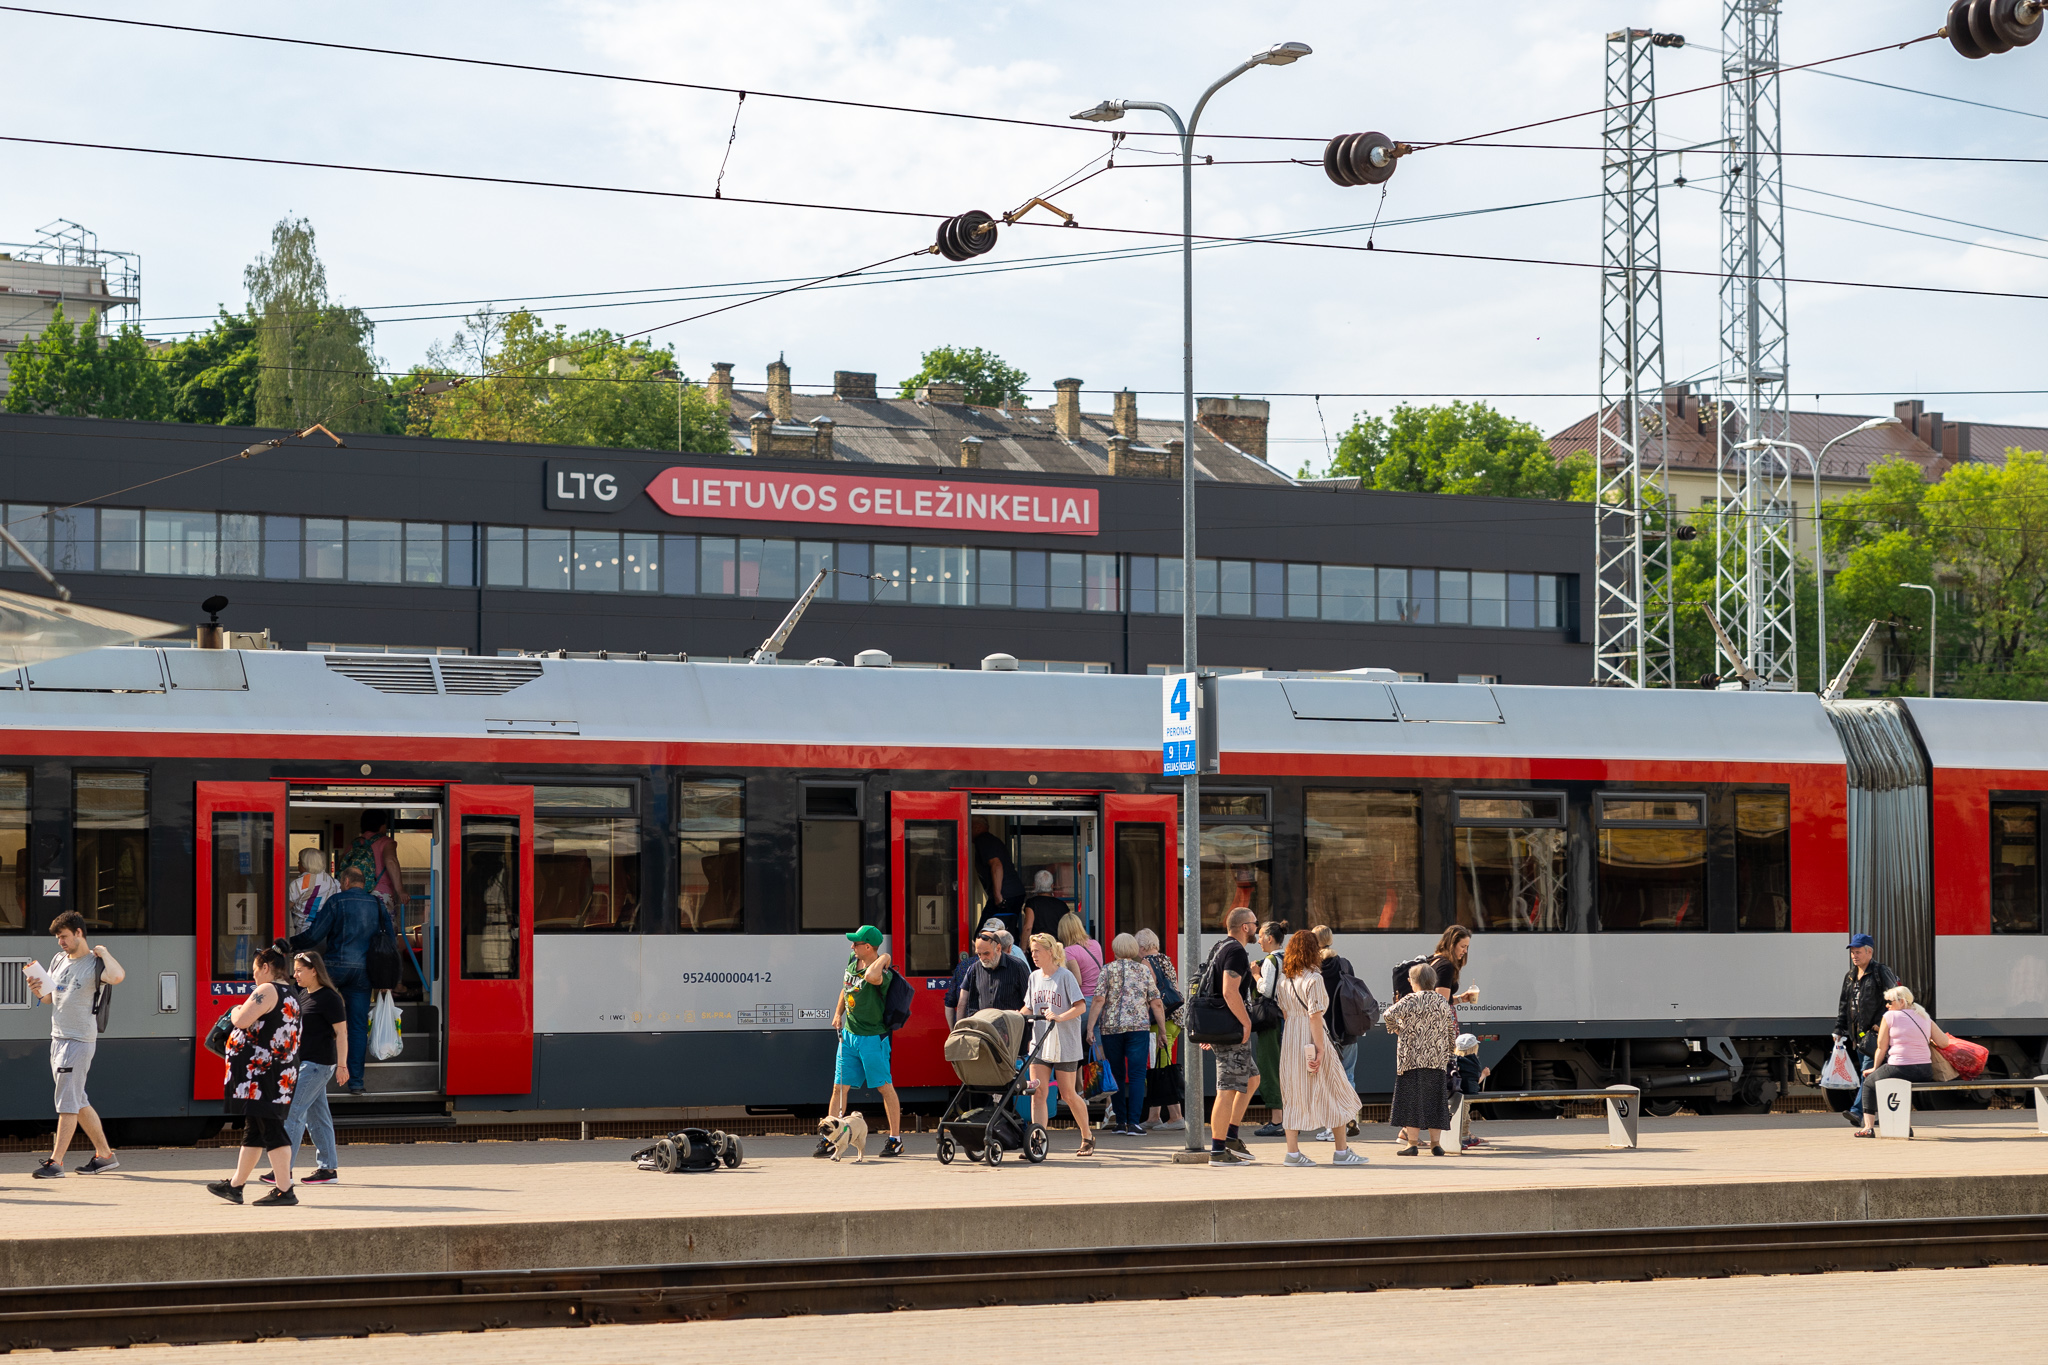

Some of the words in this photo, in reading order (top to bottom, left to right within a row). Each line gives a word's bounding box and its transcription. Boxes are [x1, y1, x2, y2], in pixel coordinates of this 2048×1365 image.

[557, 472, 618, 501] LTG
[672, 477, 837, 513] LIETUVOS
[849, 486, 1090, 525] GELEŽINKELIAI
[1171, 679, 1190, 720] 4
[1167, 726, 1191, 736] PERONAS
[1169, 746, 1174, 758] 9
[1184, 745, 1190, 757] 7
[236, 899, 247, 924] 1
[926, 900, 936, 924] 1
[682, 972, 772, 984] 95240000041-2
[1470, 1003, 1522, 1011] kondicionavimas
